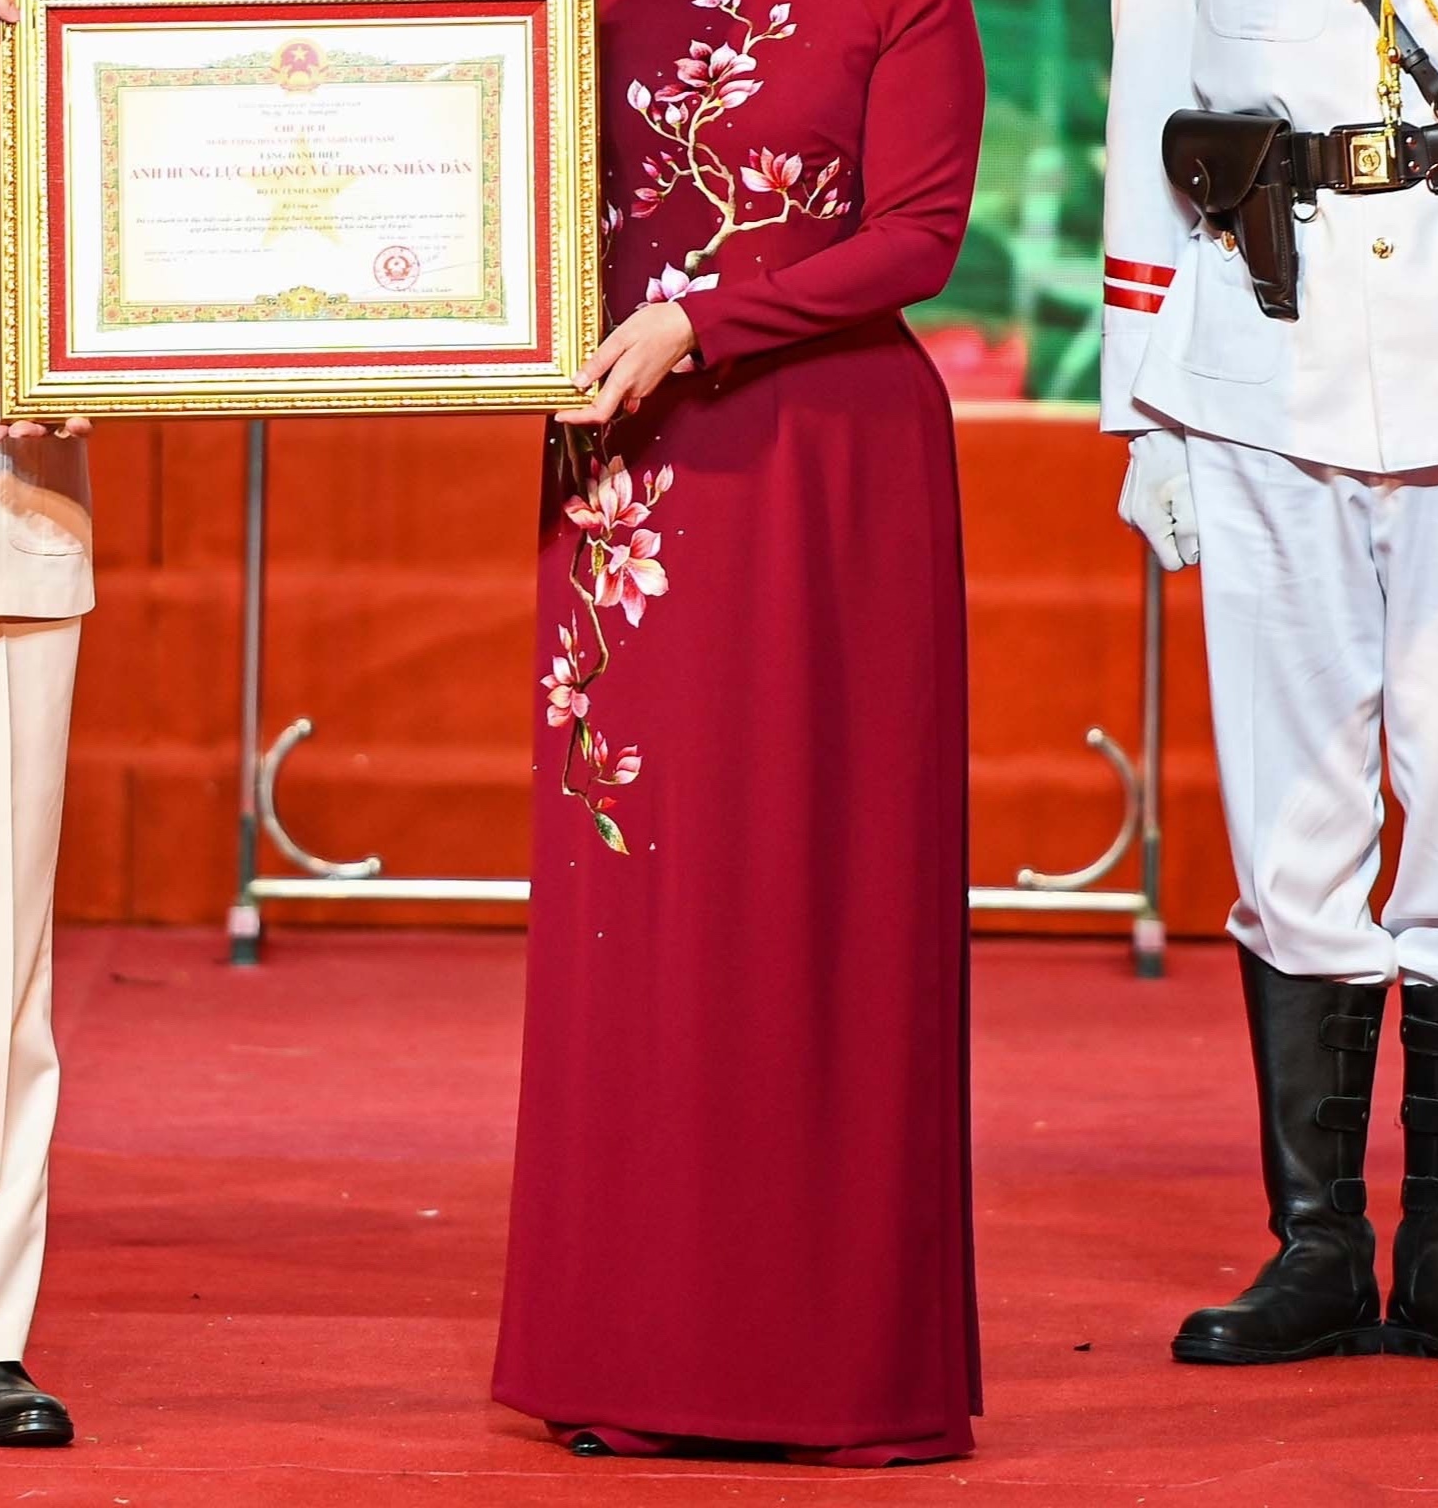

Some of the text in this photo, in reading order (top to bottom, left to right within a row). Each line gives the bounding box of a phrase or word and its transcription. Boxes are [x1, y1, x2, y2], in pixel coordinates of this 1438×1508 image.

[130, 167, 163, 180] ANH
[215, 164, 246, 181] LỰC
[336, 163, 389, 177] TRANG
[392, 159, 436, 175] NHÂN
[440, 158, 473, 174] DÂN
